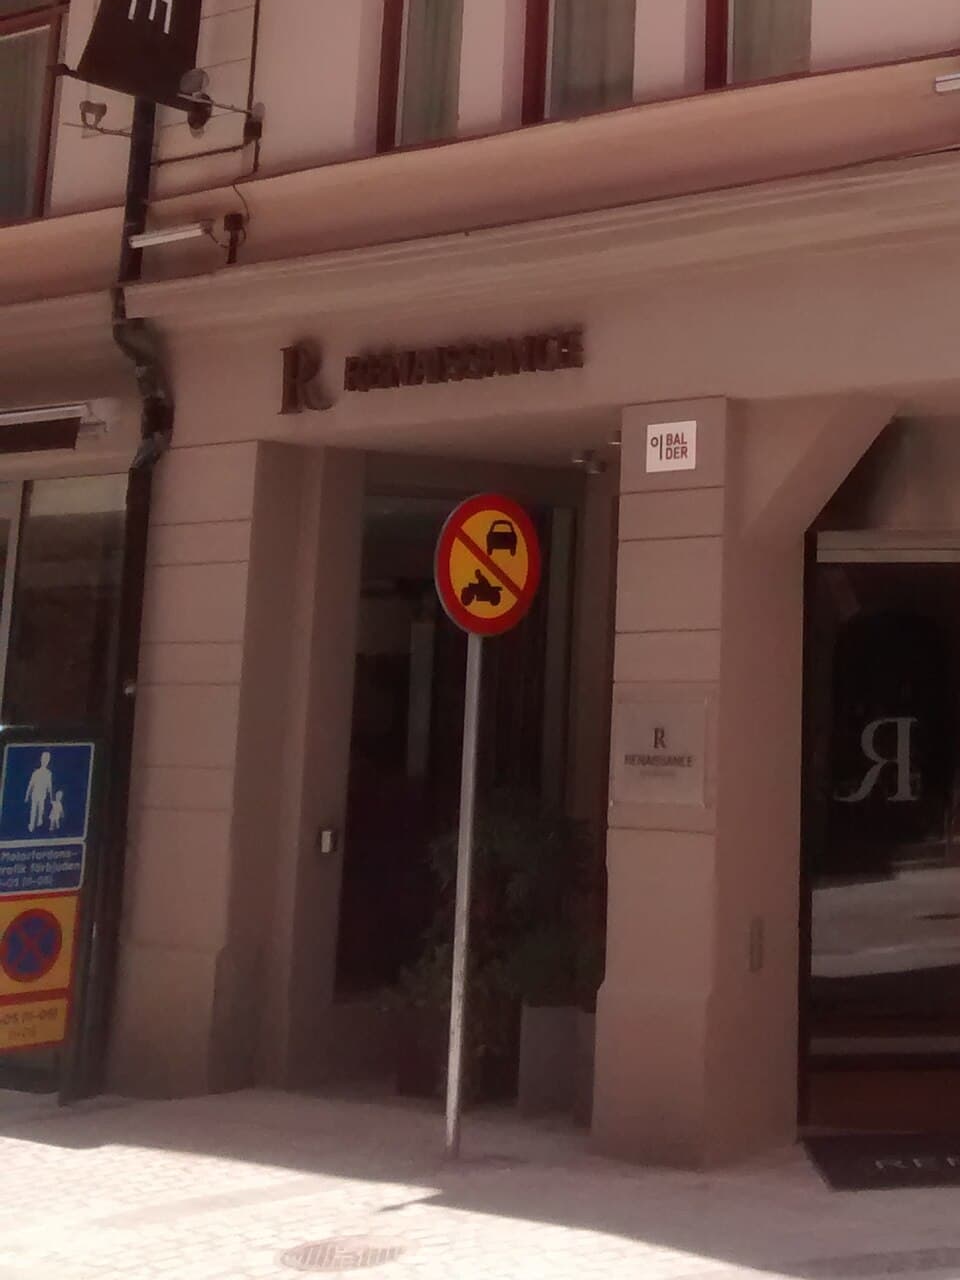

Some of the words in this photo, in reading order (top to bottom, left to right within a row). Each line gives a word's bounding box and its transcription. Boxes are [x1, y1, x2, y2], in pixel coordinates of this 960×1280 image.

[271, 334, 334, 415] R
[665, 431, 688, 446] BAL
[665, 446, 688, 460] DER
[653, 727, 667, 749] R
